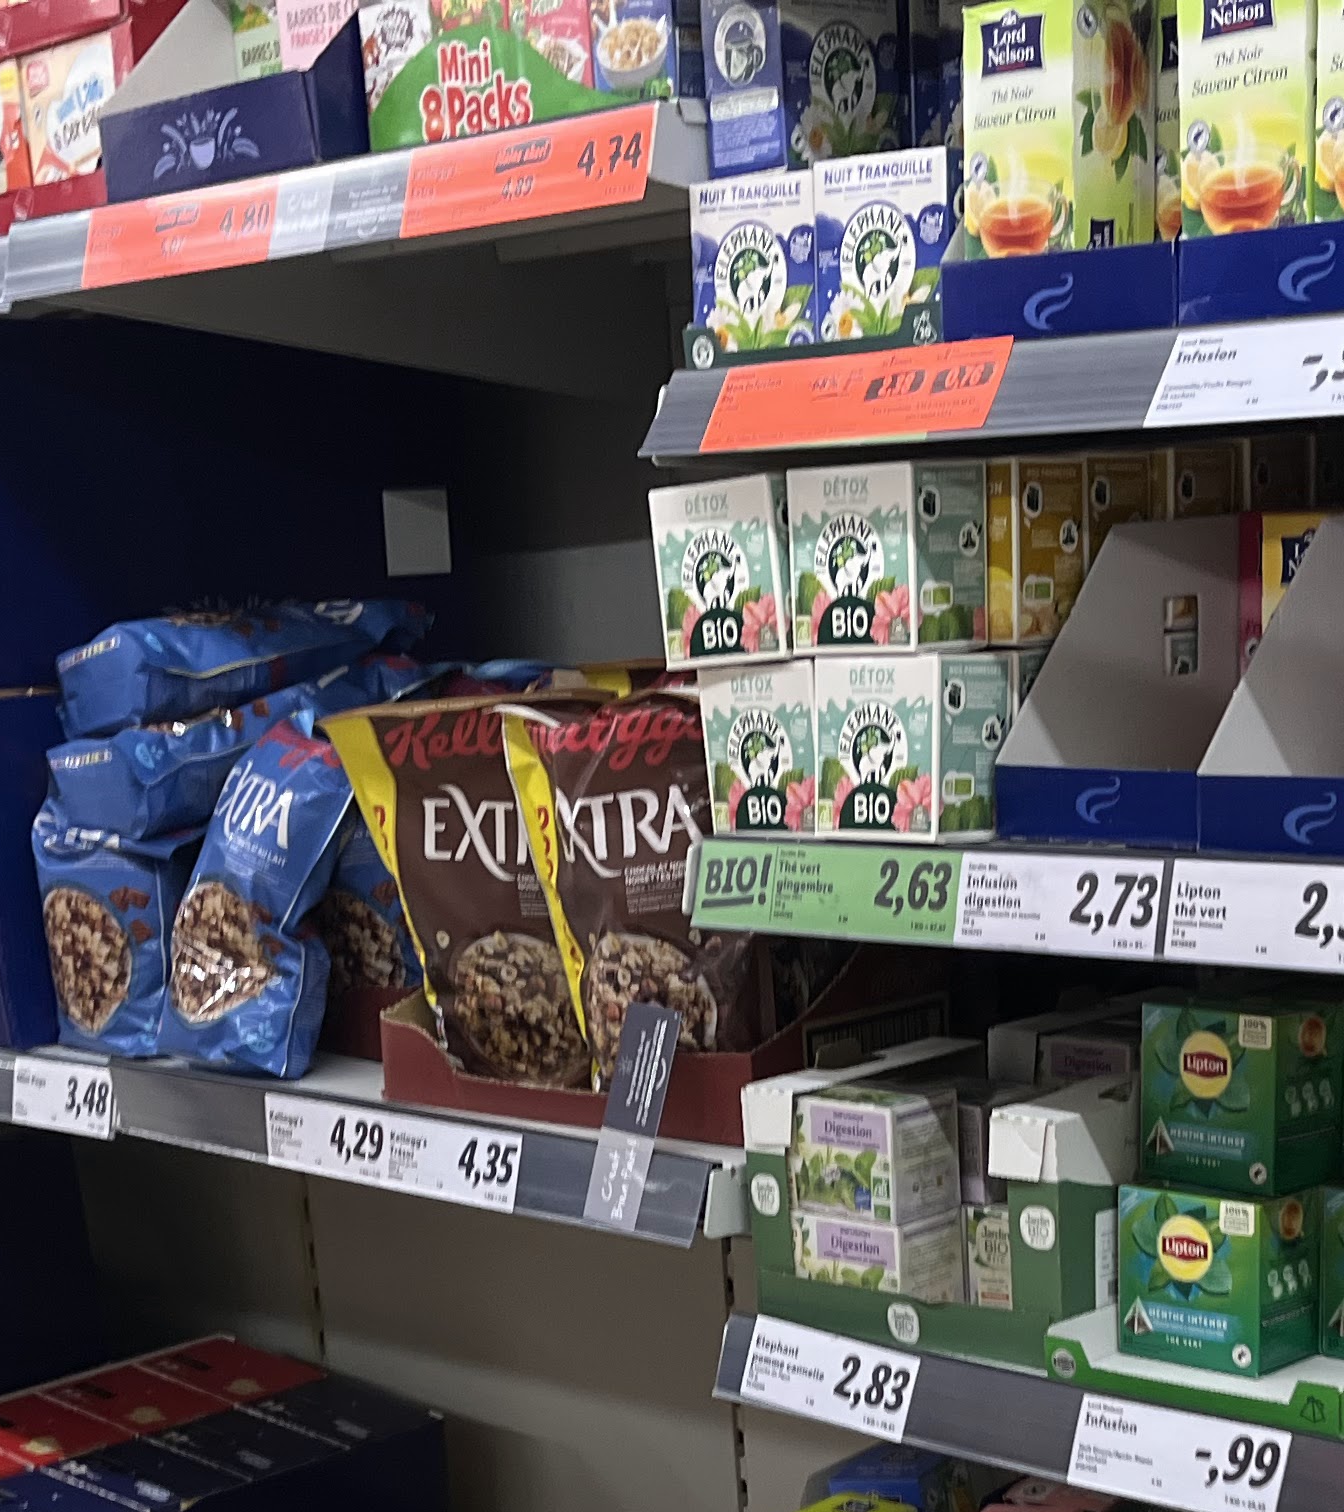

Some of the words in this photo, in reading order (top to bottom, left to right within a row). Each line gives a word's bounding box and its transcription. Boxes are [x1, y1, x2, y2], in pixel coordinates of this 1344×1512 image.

[991, 25, 1027, 48] Lord
[438, 39, 491, 83] Mini
[987, 43, 1036, 67] Nelson
[1191, 74, 1234, 98] Saveur
[1238, 64, 1290, 88] Citron
[421, 90, 446, 142] 8
[447, 76, 534, 137] Packs
[576, 132, 644, 180] 4,74
[823, 167, 853, 185] NUIT
[857, 158, 934, 181] TRANQUILLE
[699, 187, 726, 206] NUIT
[731, 182, 802, 204] TRANQUILLE
[1175, 345, 1238, 366] Infusion
[822, 477, 869, 498] DÉTOX
[684, 494, 729, 514] DÉTOX
[849, 667, 896, 686] DÉTOX
[779, 859, 798, 875] Thé
[801, 863, 821, 876] vert
[704, 855, 772, 906] BIO!
[776, 877, 833, 895] gingembre
[874, 860, 952, 915] 2,63
[967, 875, 1018, 891] Infusion
[1177, 883, 1221, 902] Lipton
[964, 892, 1021, 911] digestion
[1070, 872, 1157, 934] 2,73
[1174, 903, 1196, 919] thé
[1199, 905, 1227, 921] vert
[66, 1076, 110, 1118] 3,48
[329, 1116, 385, 1162] 4,29
[824, 1121, 873, 1142] Digestion
[457, 1136, 515, 1186] 4,35
[830, 1235, 880, 1259] Digestion
[1162, 1238, 1206, 1261] Lipton
[756, 1334, 799, 1361] Elephant
[833, 1355, 912, 1412] 2,83
[1084, 1414, 1138, 1437] Infusion
[1194, 1435, 1282, 1487] -,99
